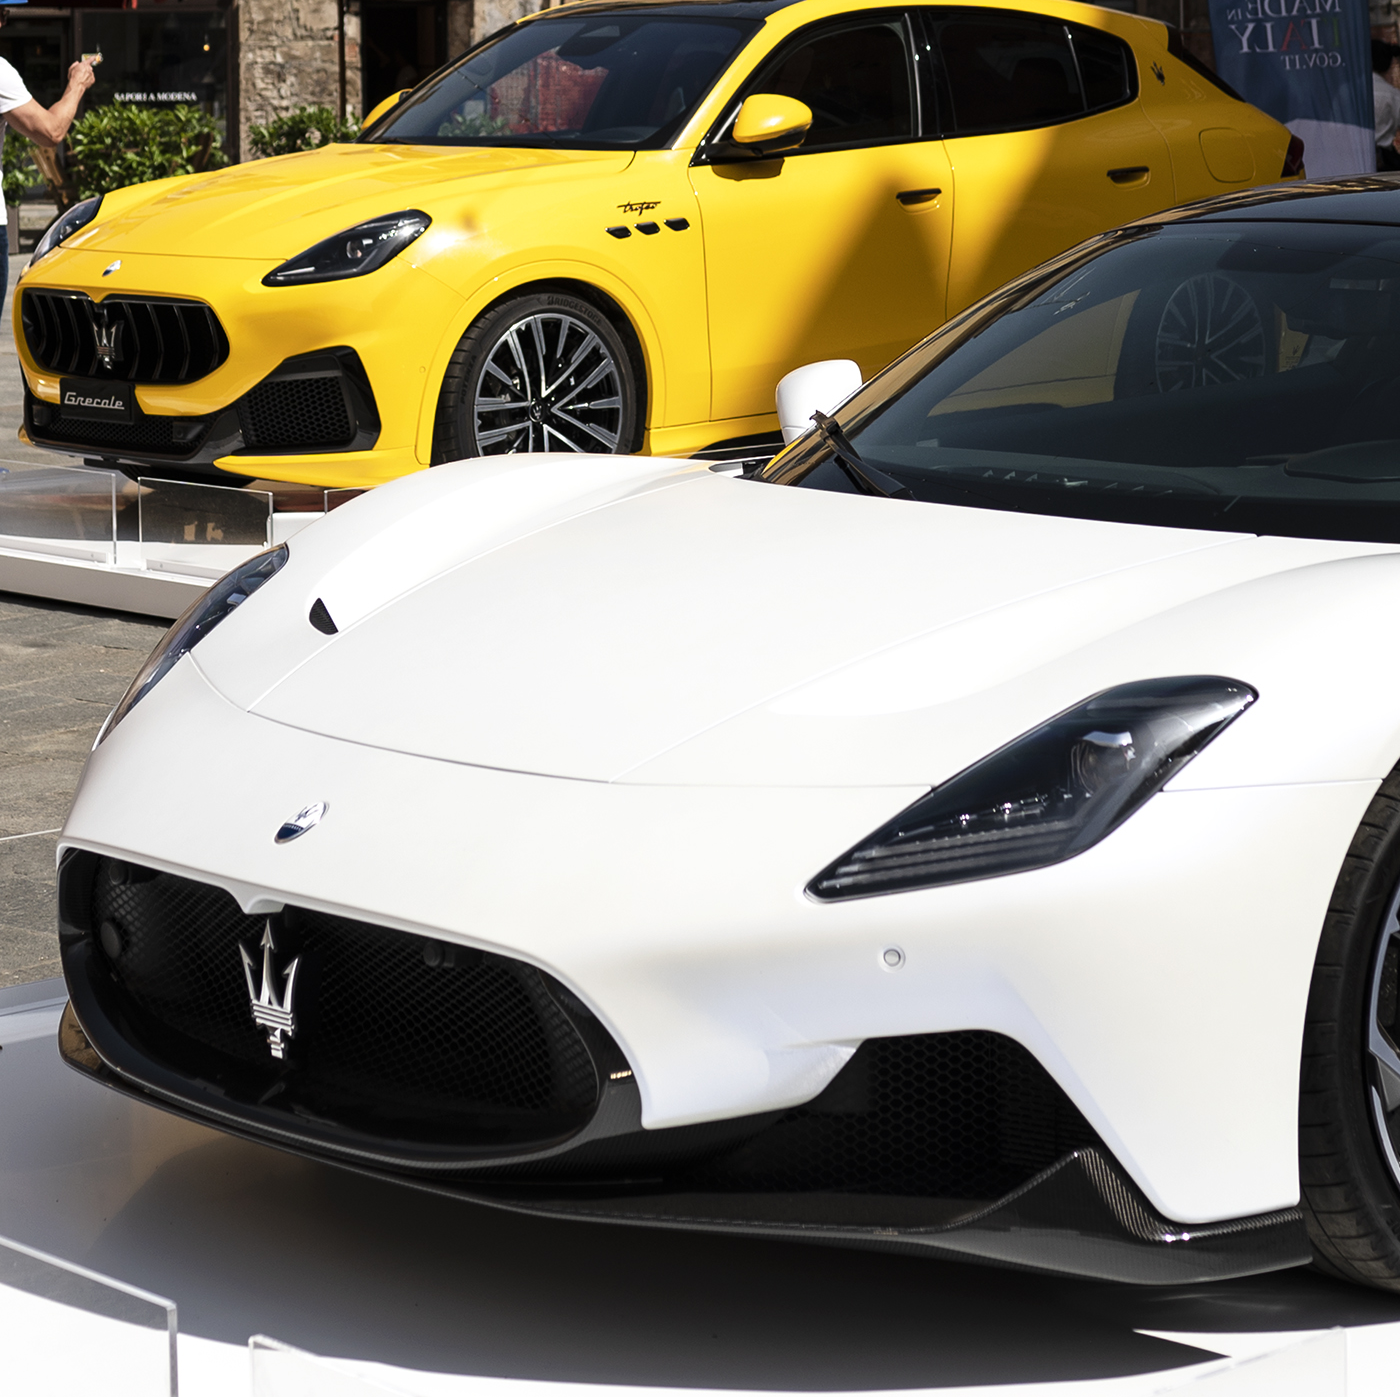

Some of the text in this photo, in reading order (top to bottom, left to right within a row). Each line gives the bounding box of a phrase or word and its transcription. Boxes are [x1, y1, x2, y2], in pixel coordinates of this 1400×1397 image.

[114, 91, 147, 102] SAPORI
[156, 91, 197, 102] MODENA
[64, 391, 125, 410] Grecale
